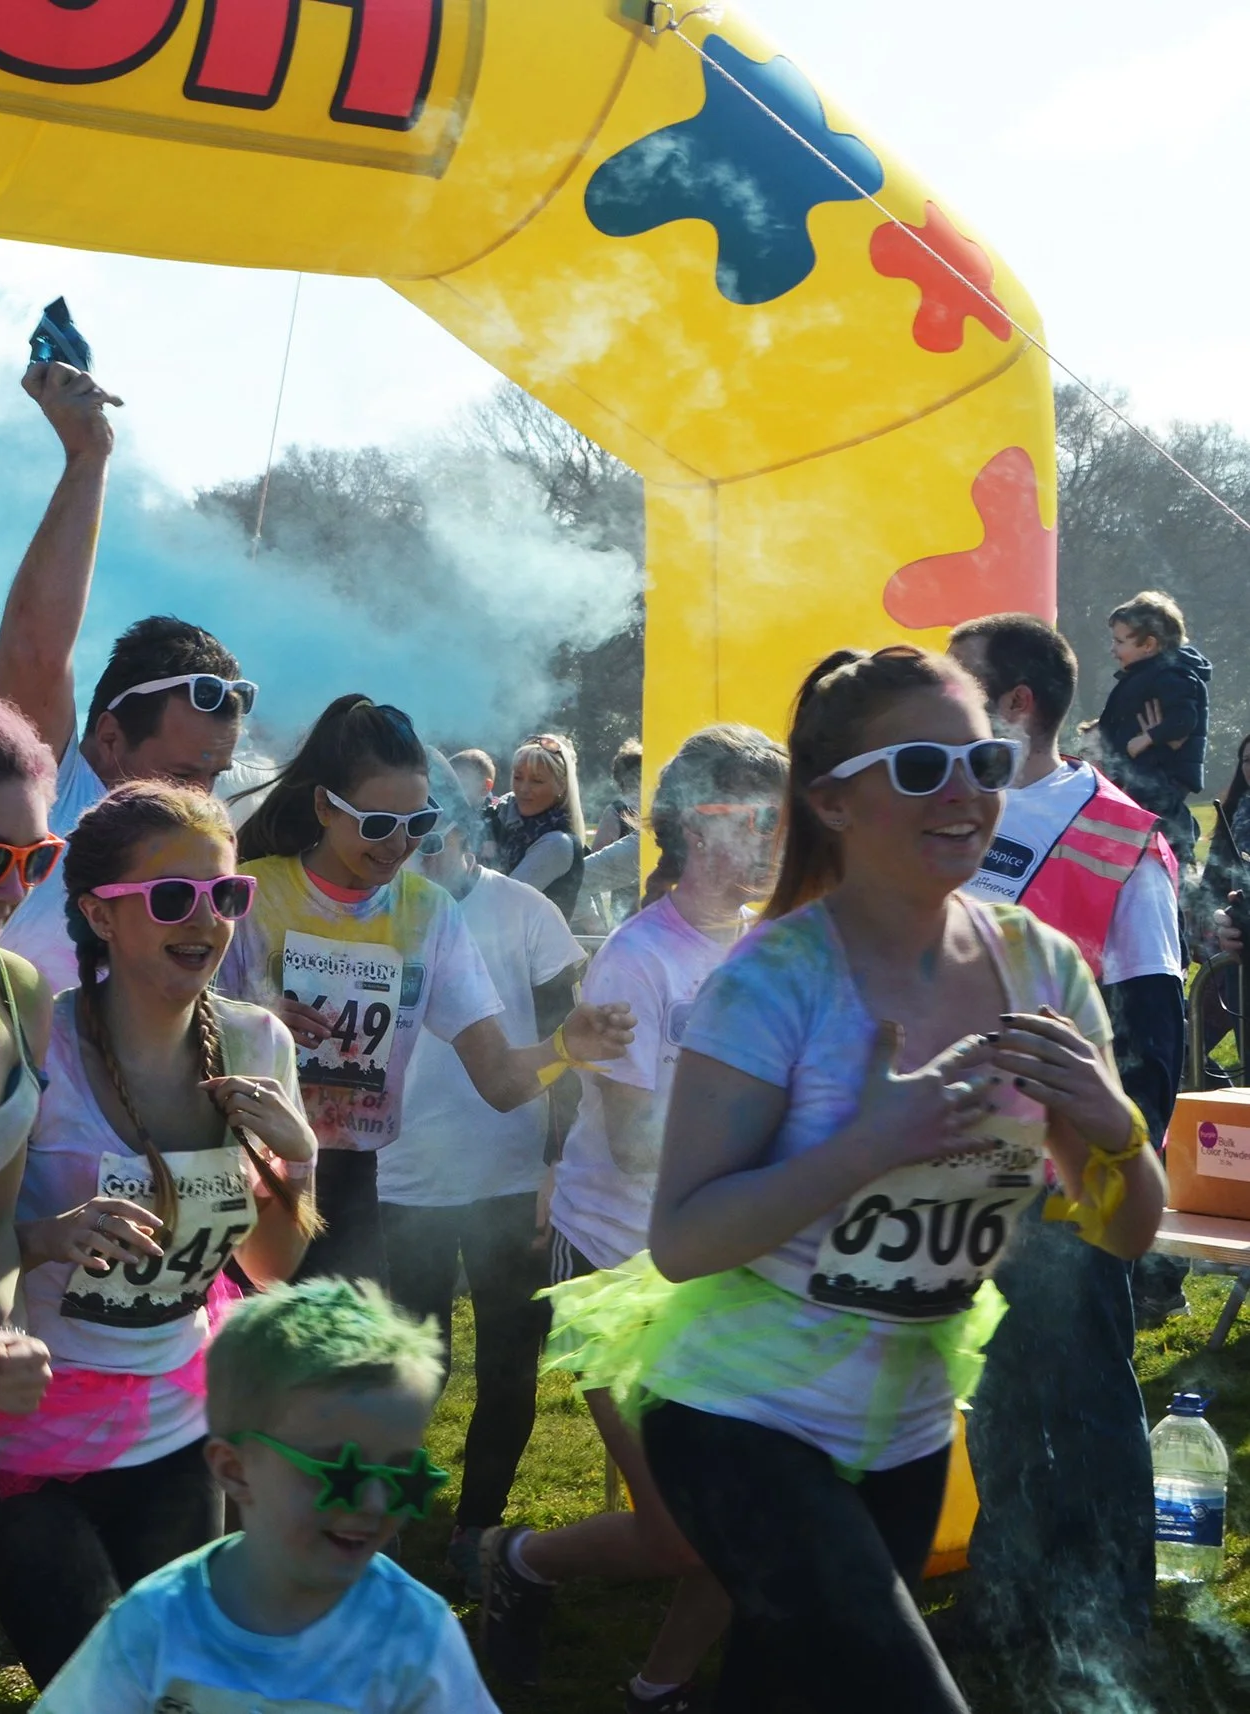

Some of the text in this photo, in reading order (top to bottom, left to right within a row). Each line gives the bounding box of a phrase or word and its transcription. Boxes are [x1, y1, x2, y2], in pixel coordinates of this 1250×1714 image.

[986, 849, 1024, 867] ospice
[283, 951, 393, 980] COLOUR RUN
[284, 989, 391, 1055] 49
[1223, 1148, 1250, 1161] Powde
[103, 1175, 209, 1198] COLUR
